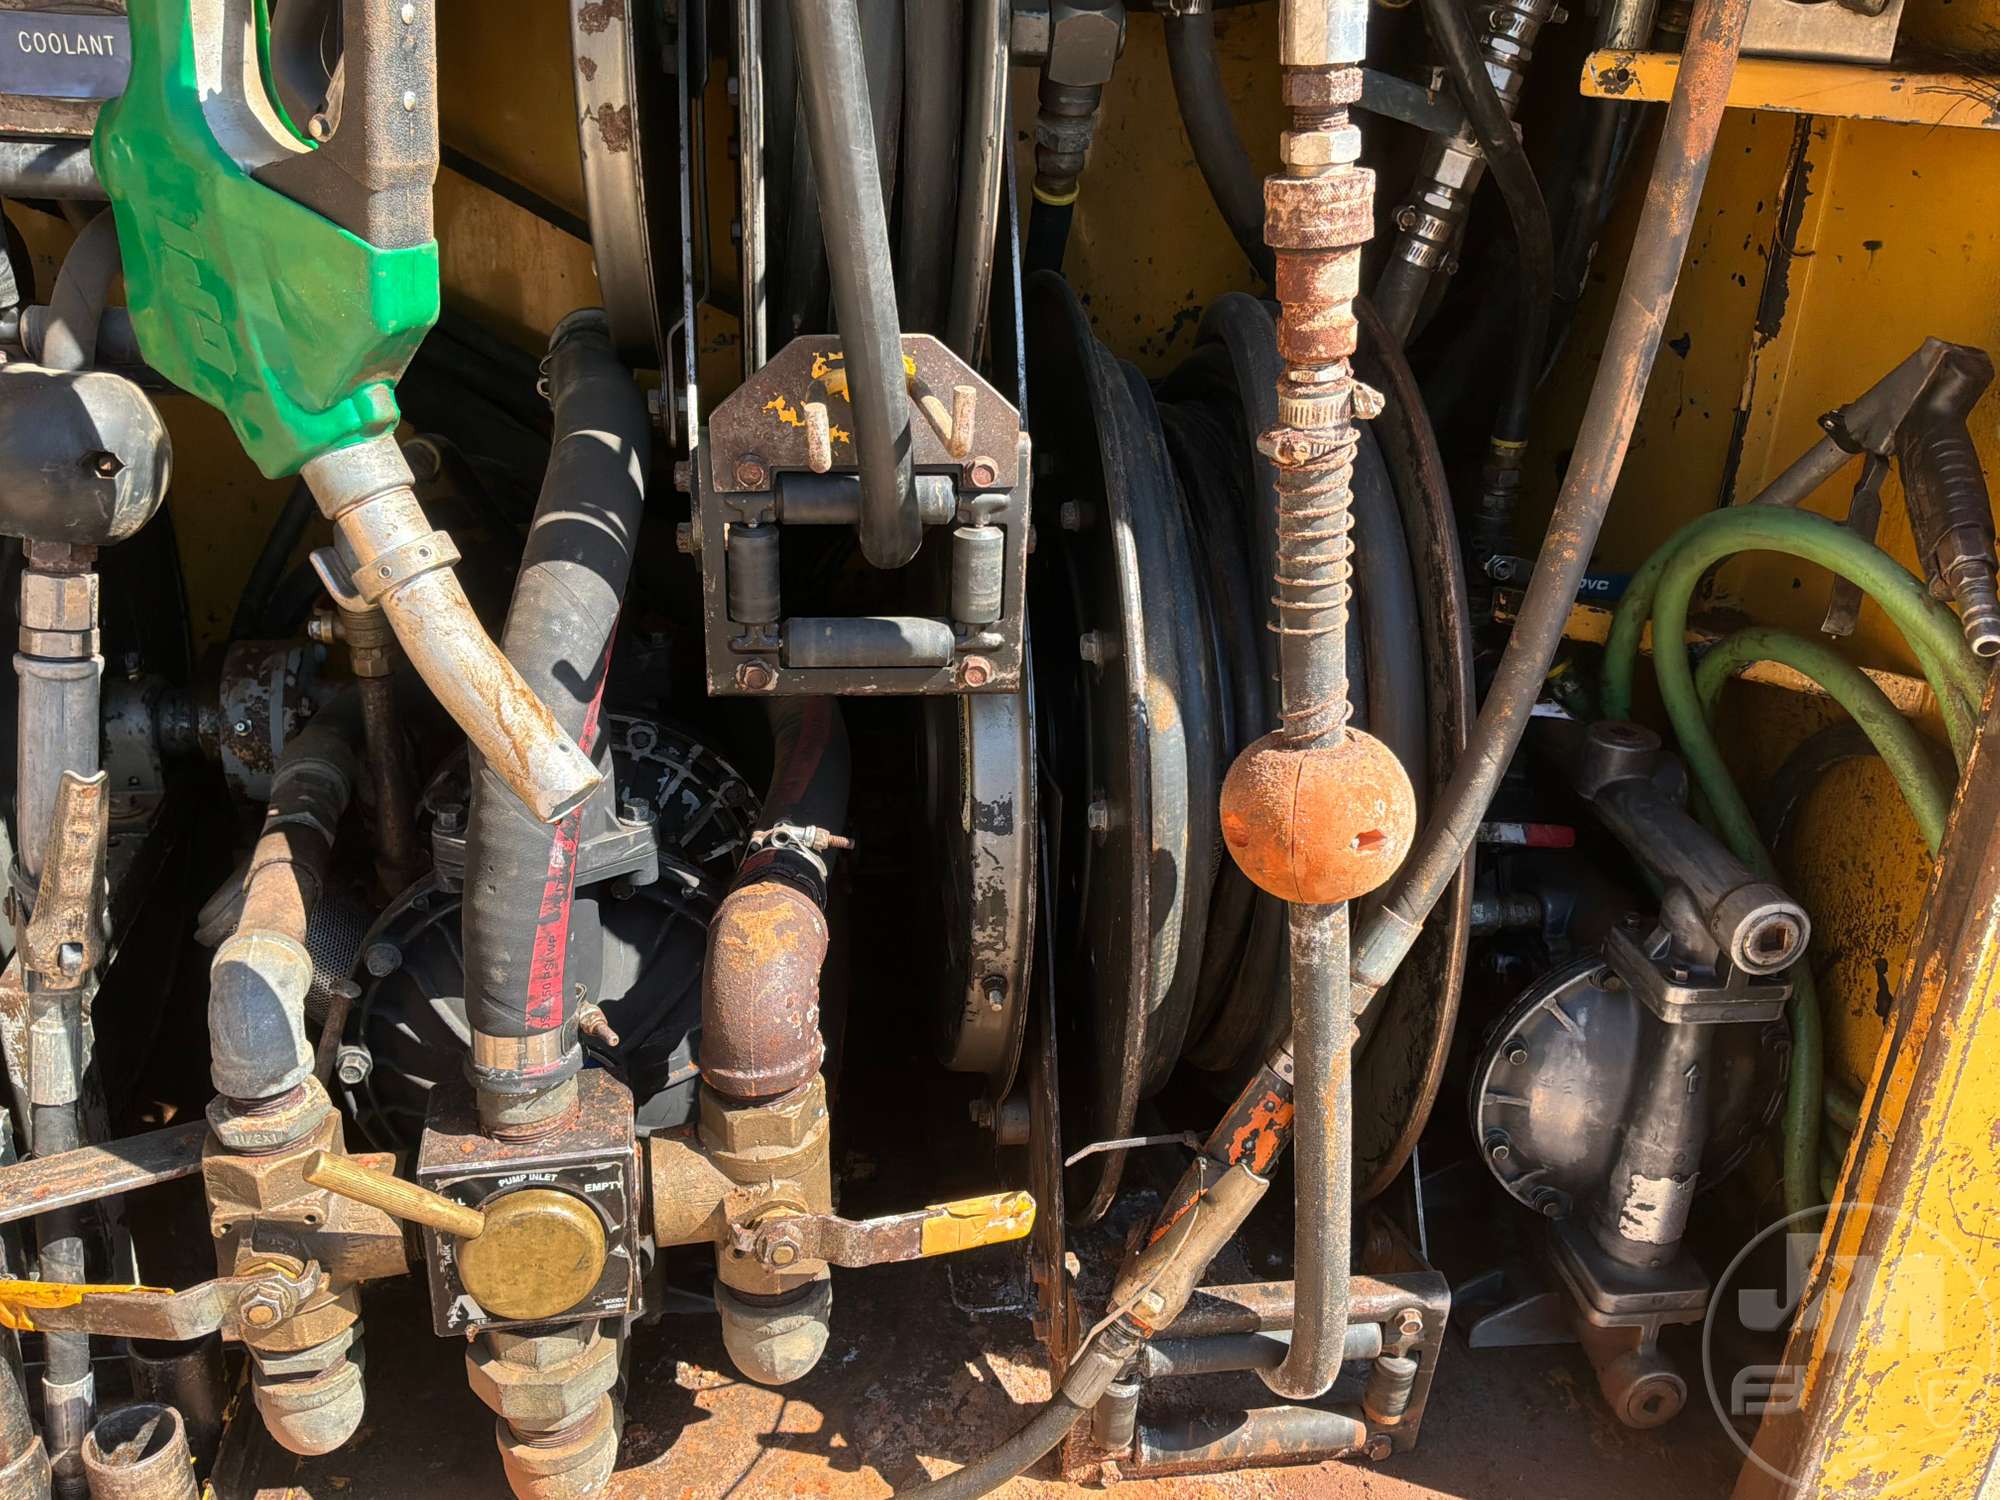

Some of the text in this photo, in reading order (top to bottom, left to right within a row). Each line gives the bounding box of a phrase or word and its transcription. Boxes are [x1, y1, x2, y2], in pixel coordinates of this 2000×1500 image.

[18, 31, 115, 56] COOLANT
[498, 1173, 558, 1188] PUMP INLET
[584, 1180, 623, 1193] EMPTY
